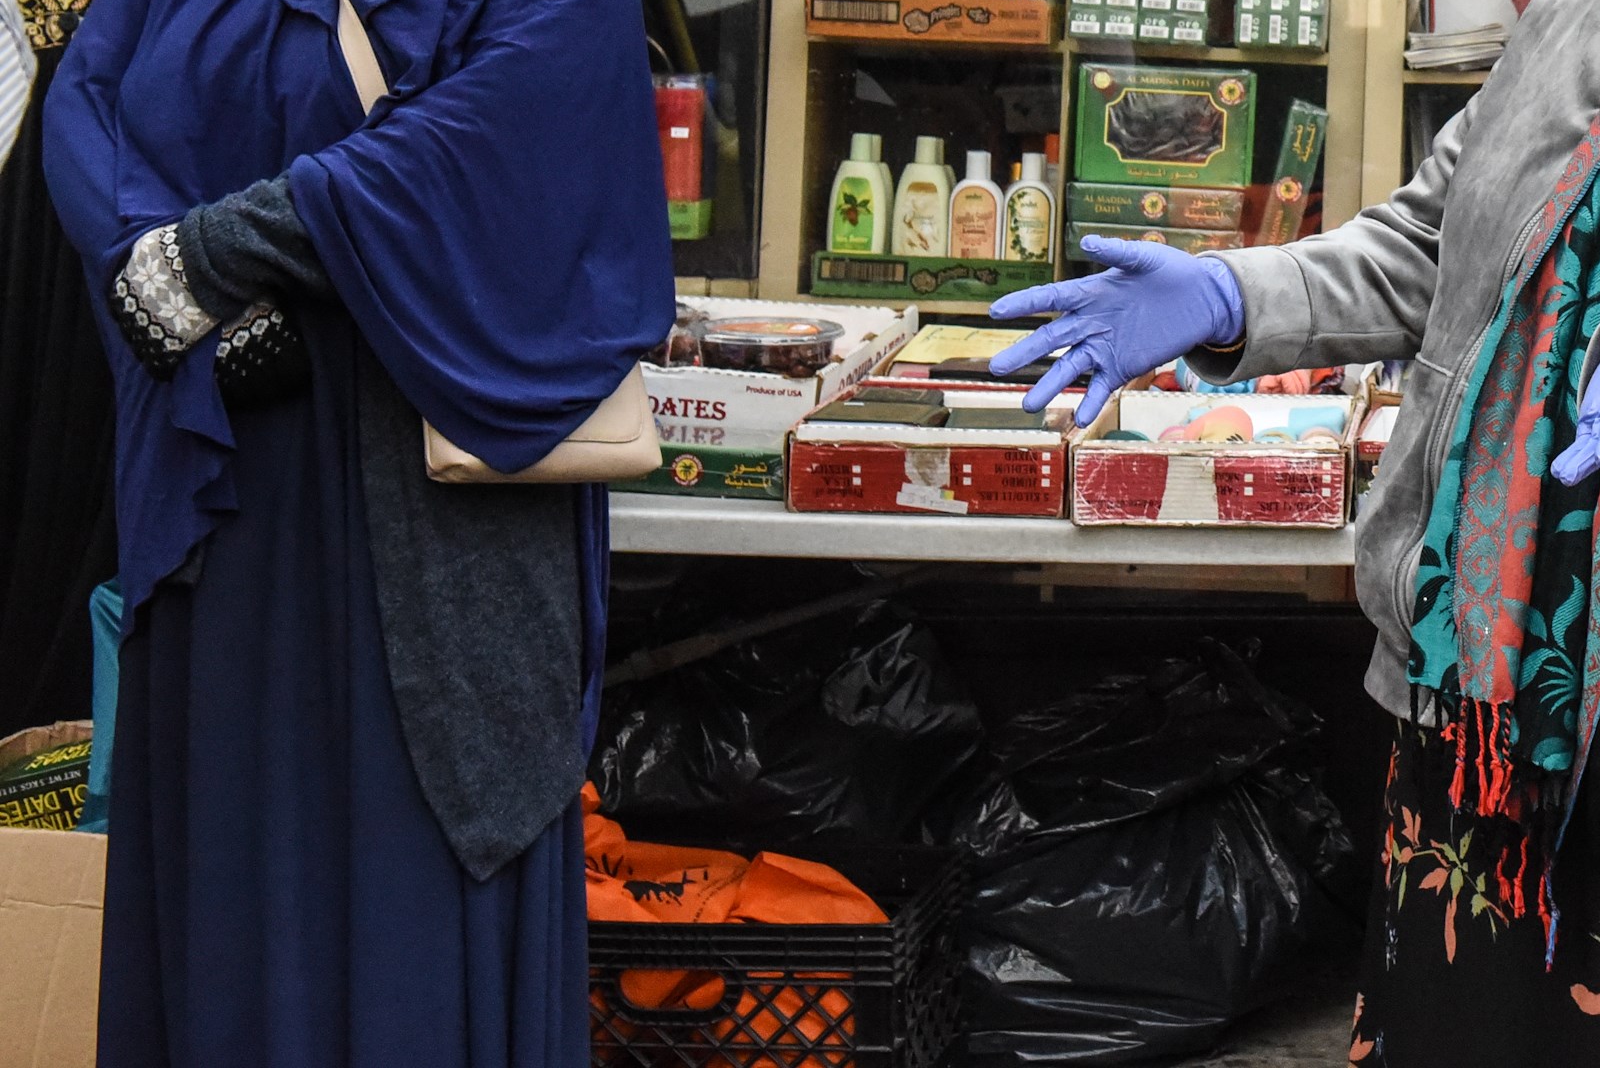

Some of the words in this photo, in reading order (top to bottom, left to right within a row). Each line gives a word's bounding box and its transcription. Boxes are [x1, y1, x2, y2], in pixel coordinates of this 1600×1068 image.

[1098, 195, 1133, 206] MADINA
[745, 385, 776, 397] Produce
[778, 388, 786, 397] of
[787, 389, 803, 398] USA
[994, 464, 1038, 474] MEDIUM
[1001, 477, 1038, 487] JUMBO
[63, 769, 82, 781] NET
[0, 790, 60, 825] DATES
